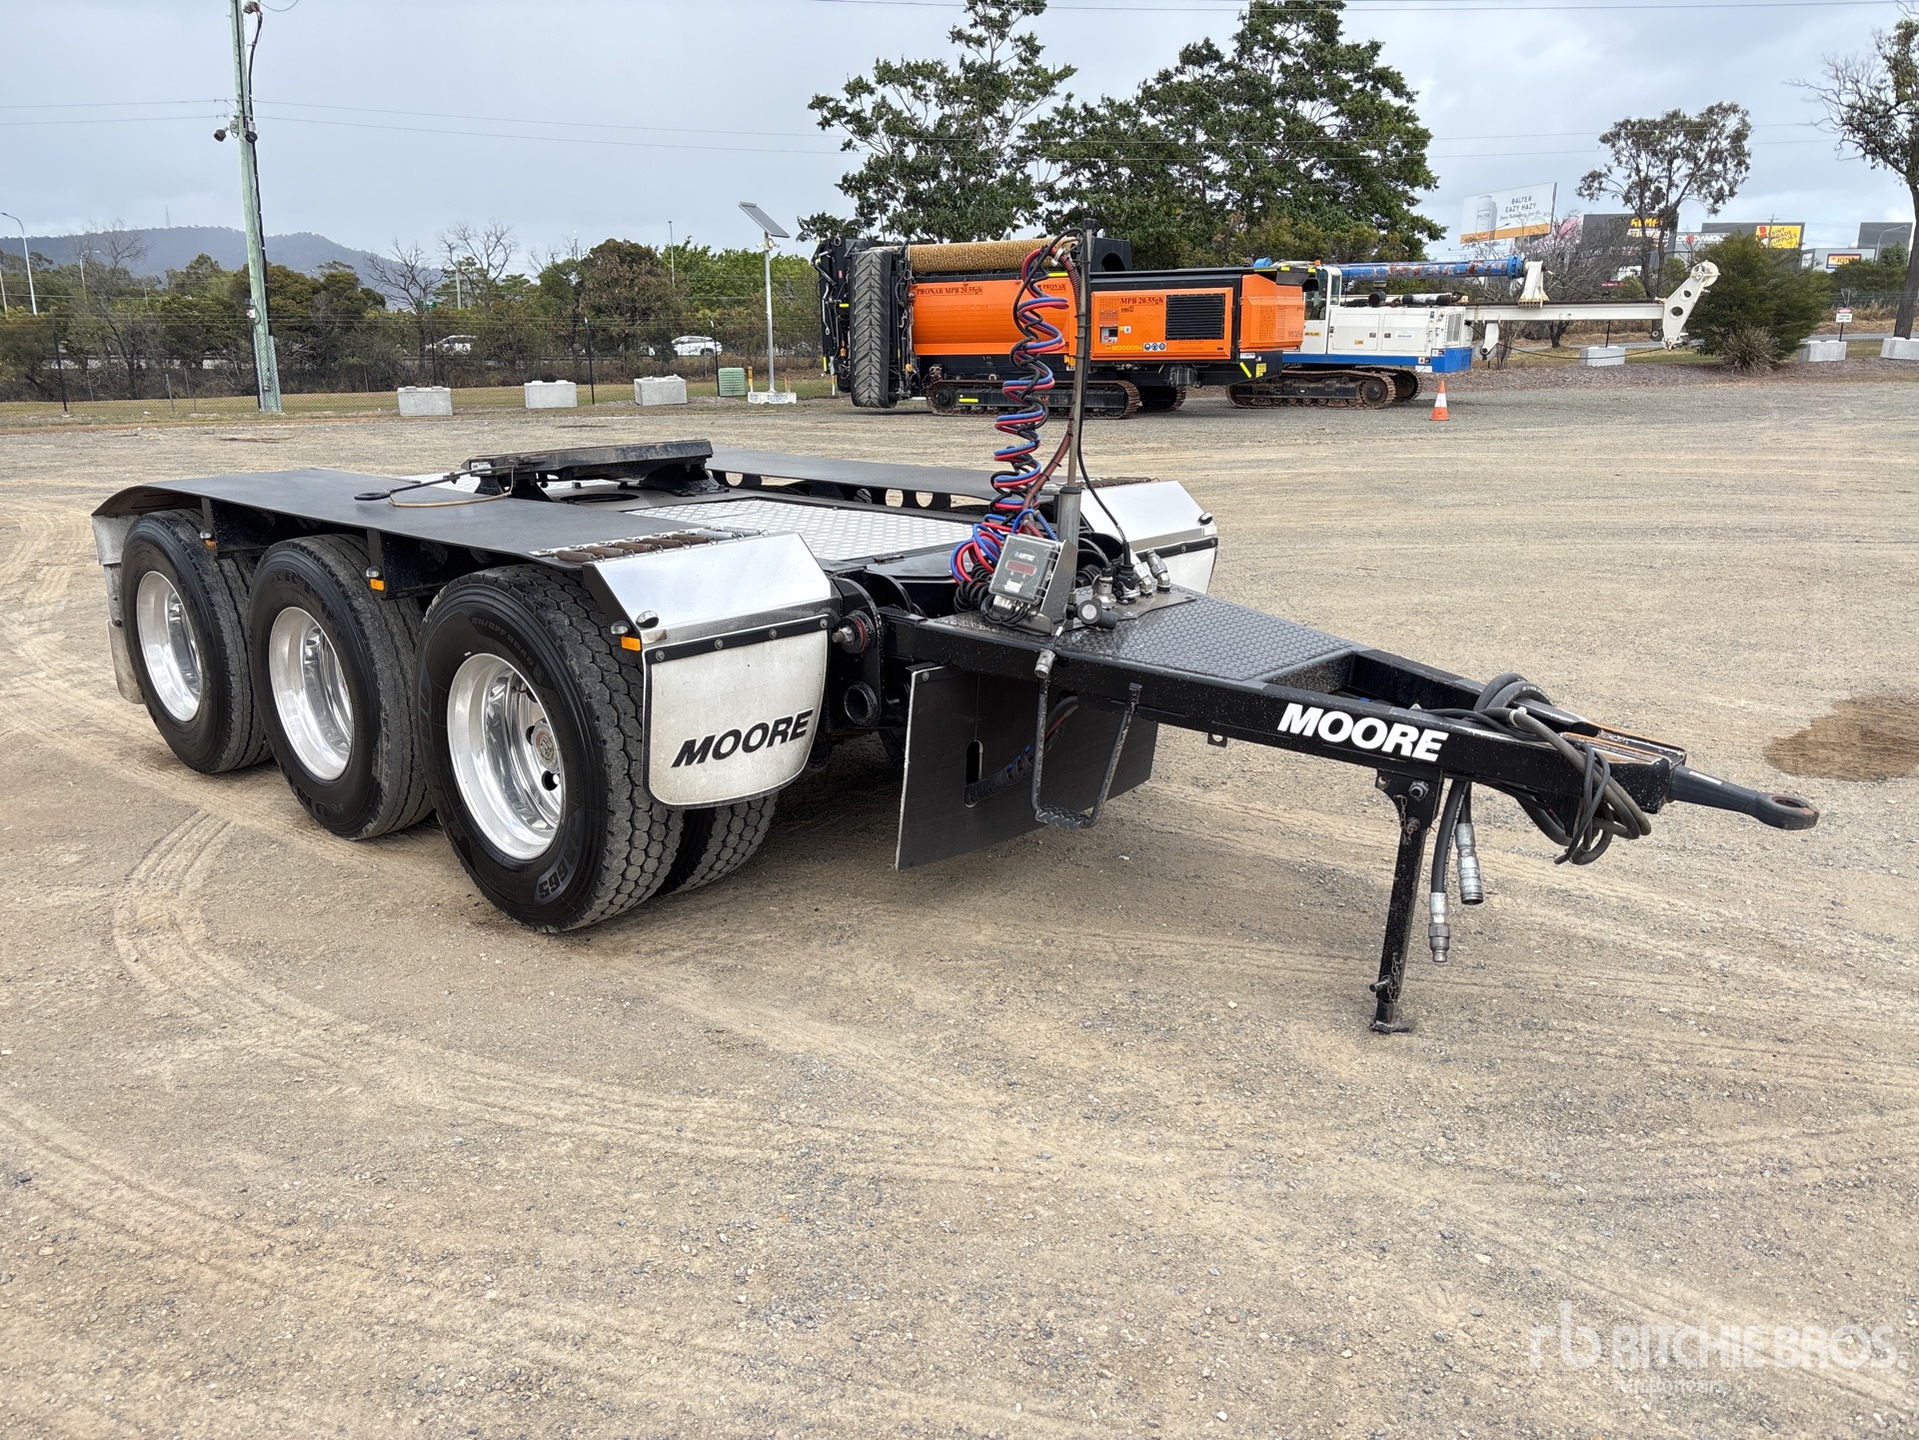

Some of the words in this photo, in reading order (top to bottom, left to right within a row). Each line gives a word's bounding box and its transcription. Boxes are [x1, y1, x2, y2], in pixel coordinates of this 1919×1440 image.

[1511, 195, 1532, 204] BALTER
[1505, 204, 1520, 213] EAZY
[916, 287, 943, 295] PRONAR
[1277, 702, 1449, 762] MOORE
[670, 708, 814, 768] MOORE
